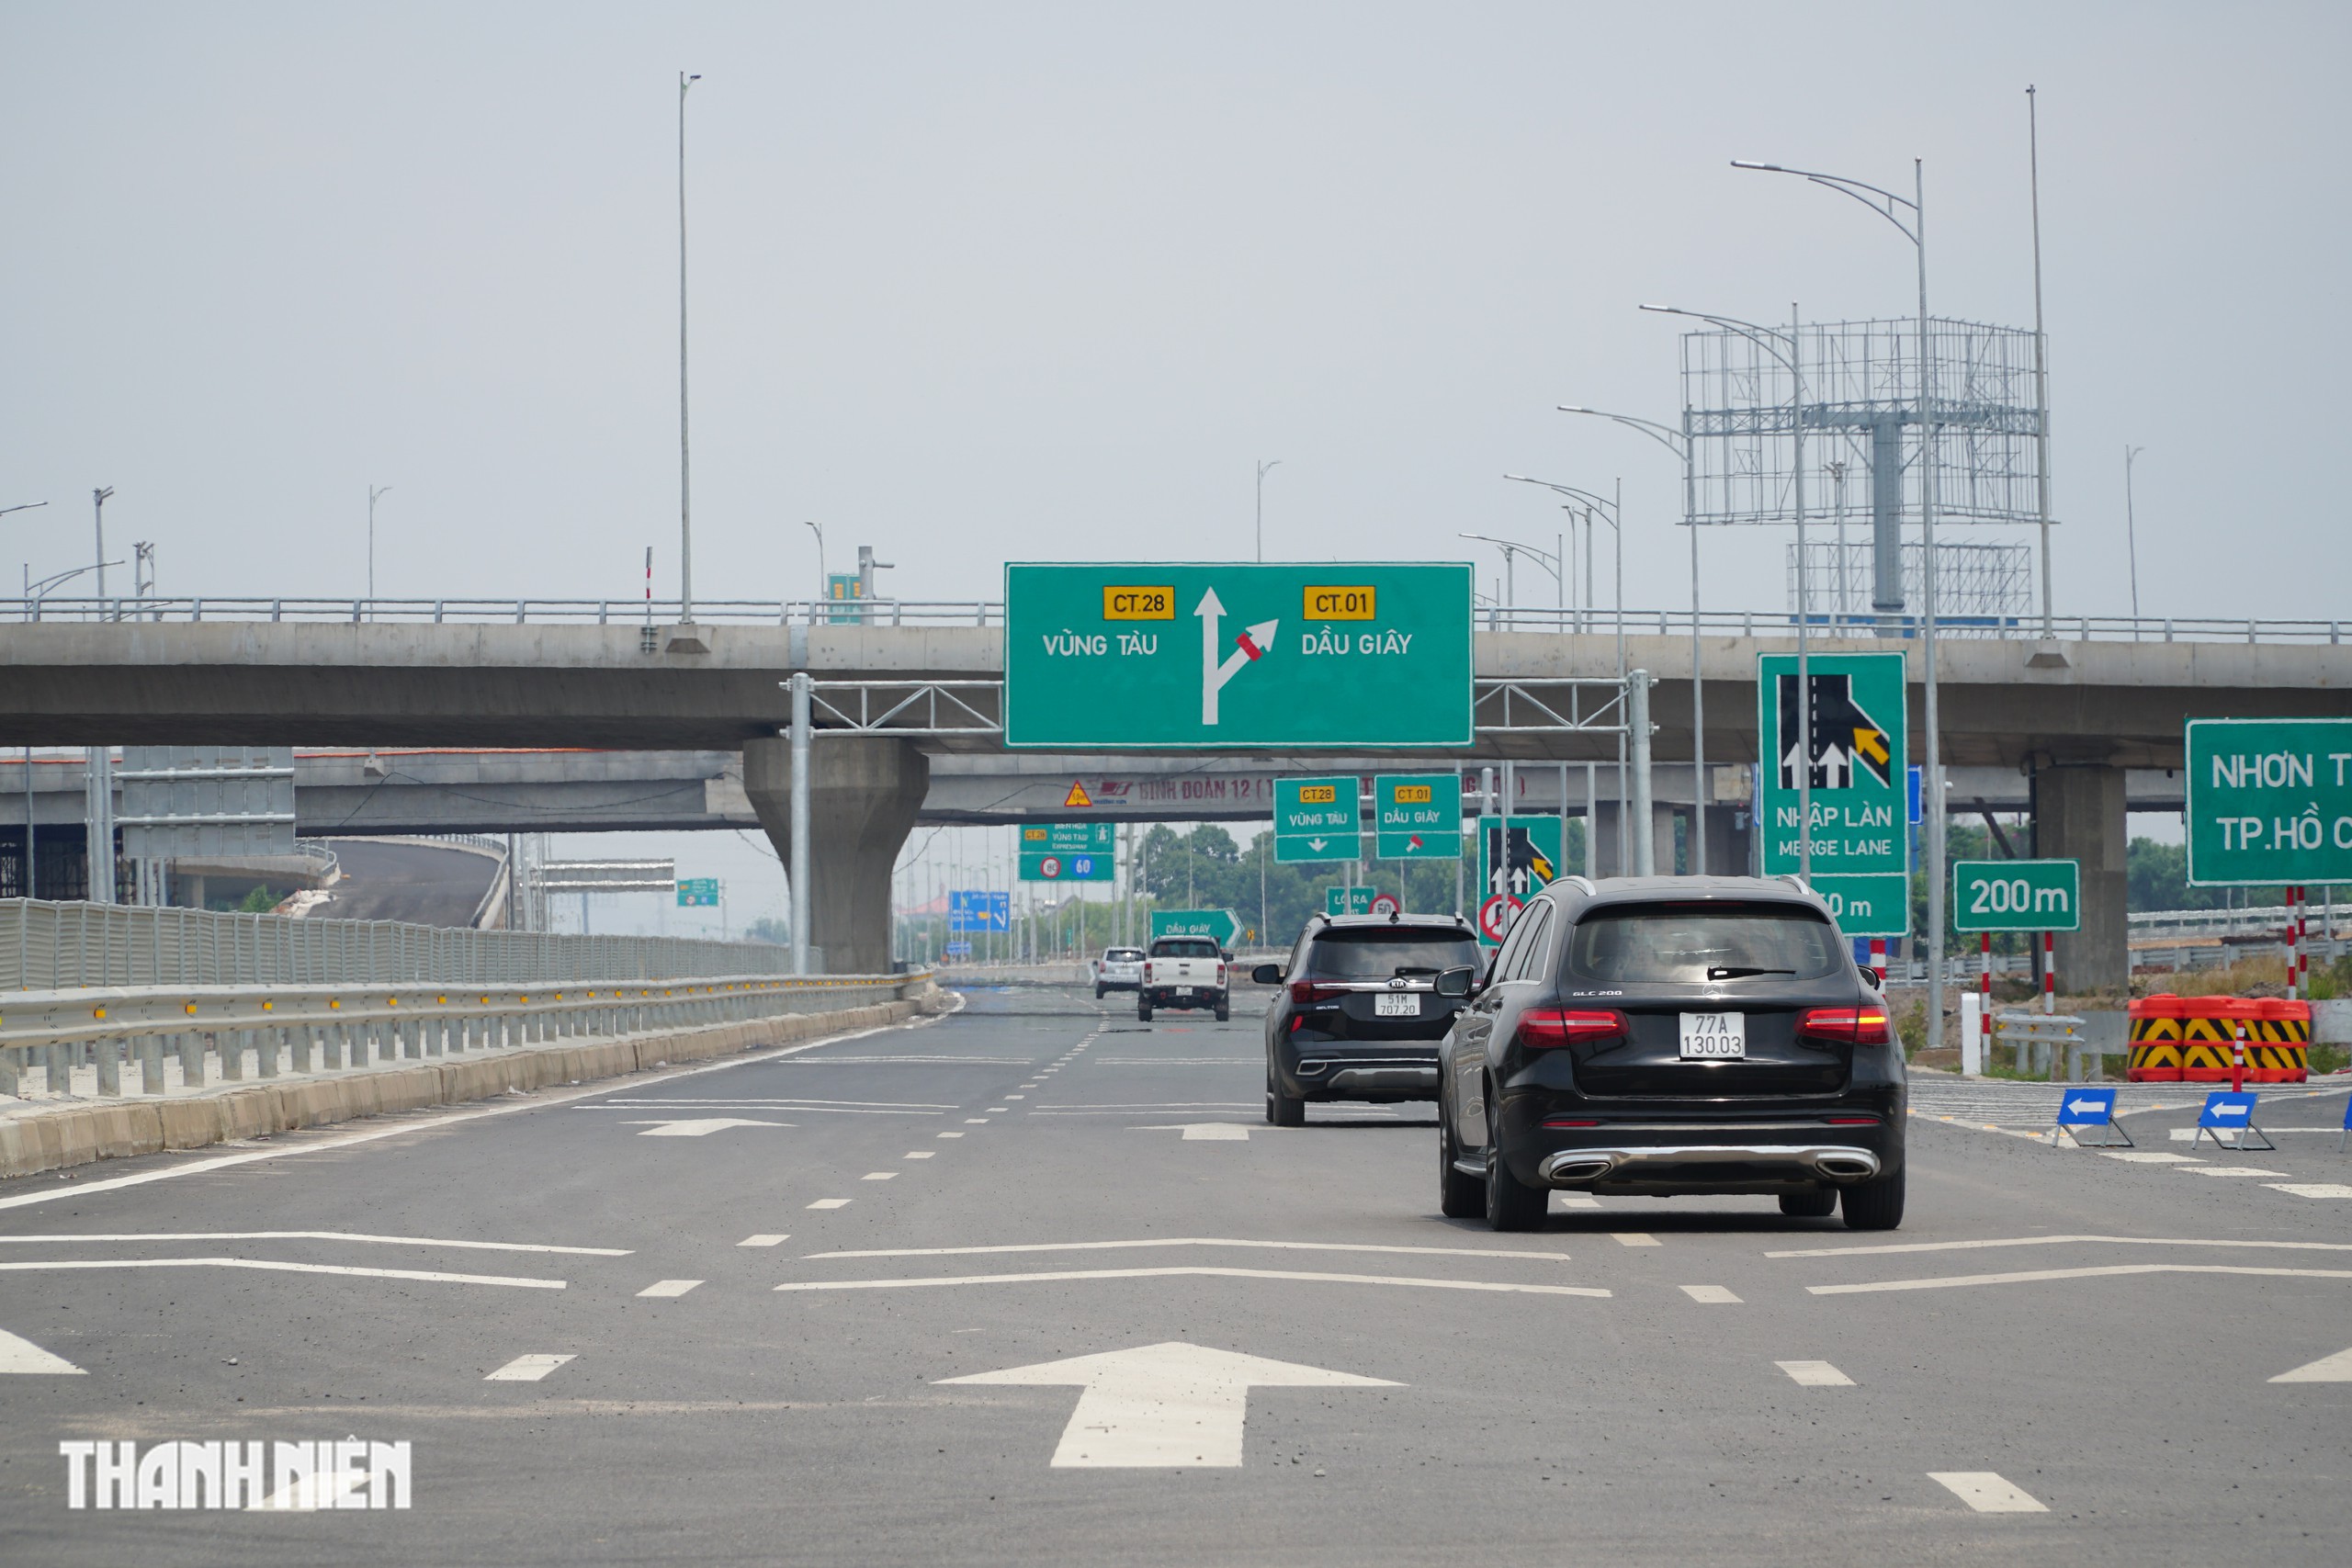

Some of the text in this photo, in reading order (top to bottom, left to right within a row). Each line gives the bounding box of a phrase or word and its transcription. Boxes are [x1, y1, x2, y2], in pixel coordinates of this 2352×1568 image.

[1114, 593, 1165, 613] CT.28
[1316, 592, 1367, 614] CT.01
[1042, 628, 1158, 656] VŨNG TÀU
[1302, 626, 1413, 655] DẦU GIÂY
[2211, 750, 2313, 789] NHƠN
[1182, 776, 1226, 799] ĐOÀN
[1231, 779, 1250, 798] 12
[1302, 789, 1331, 800] CT.28
[1397, 789, 1429, 800] CT.01
[1289, 811, 1323, 827] VŨNG
[1384, 807, 1441, 824] DẦU GIÂY
[1844, 800, 1892, 828] LÀN
[1779, 840, 1892, 856] MERGE LANE
[1076, 859, 1091, 874] 60
[1352, 895, 1368, 905] RA
[1819, 893, 1871, 917] 0 m
[1387, 994, 1408, 1004] 51M
[1380, 1004, 1416, 1014] 707.20
[1695, 1015, 1727, 1034] 77A
[1683, 1035, 1742, 1055] 130.03
